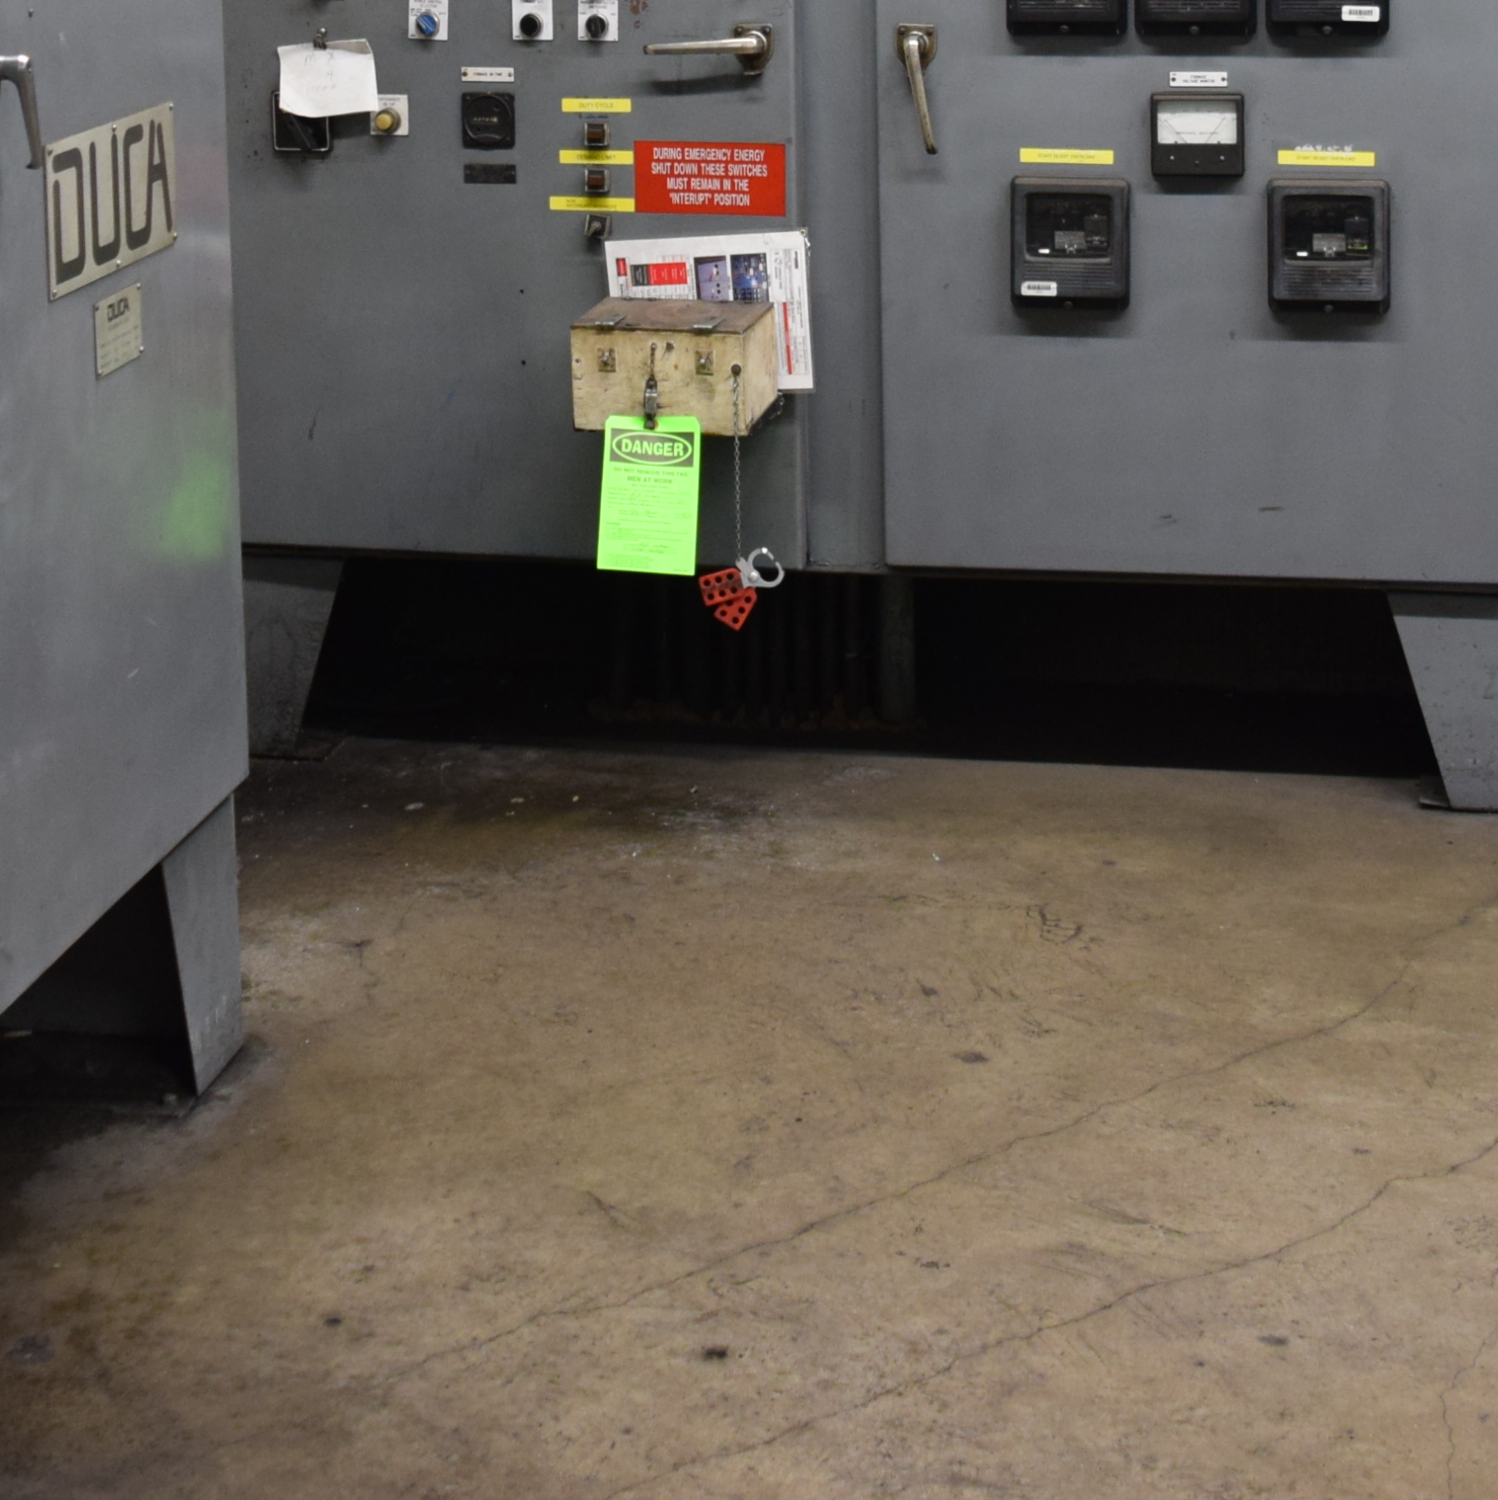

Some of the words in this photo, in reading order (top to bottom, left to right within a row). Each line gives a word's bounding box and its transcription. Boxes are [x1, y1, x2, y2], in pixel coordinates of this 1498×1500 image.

[653, 147, 682, 160] DURING
[684, 148, 731, 161] EMERGENCY
[734, 149, 765, 162] ENERGY
[651, 162, 671, 175] SHUT
[674, 162, 698, 175] DOWN
[700, 163, 726, 176] THESE
[728, 164, 768, 177] SWITCHES
[667, 177, 688, 190] MUST
[691, 178, 720, 190] REMAIN
[722, 178, 731, 190] IN
[733, 179, 749, 191] THE
[52, 119, 173, 285] DUCA
[714, 193, 750, 206] POSITION
[622, 438, 684, 457] DANGER
